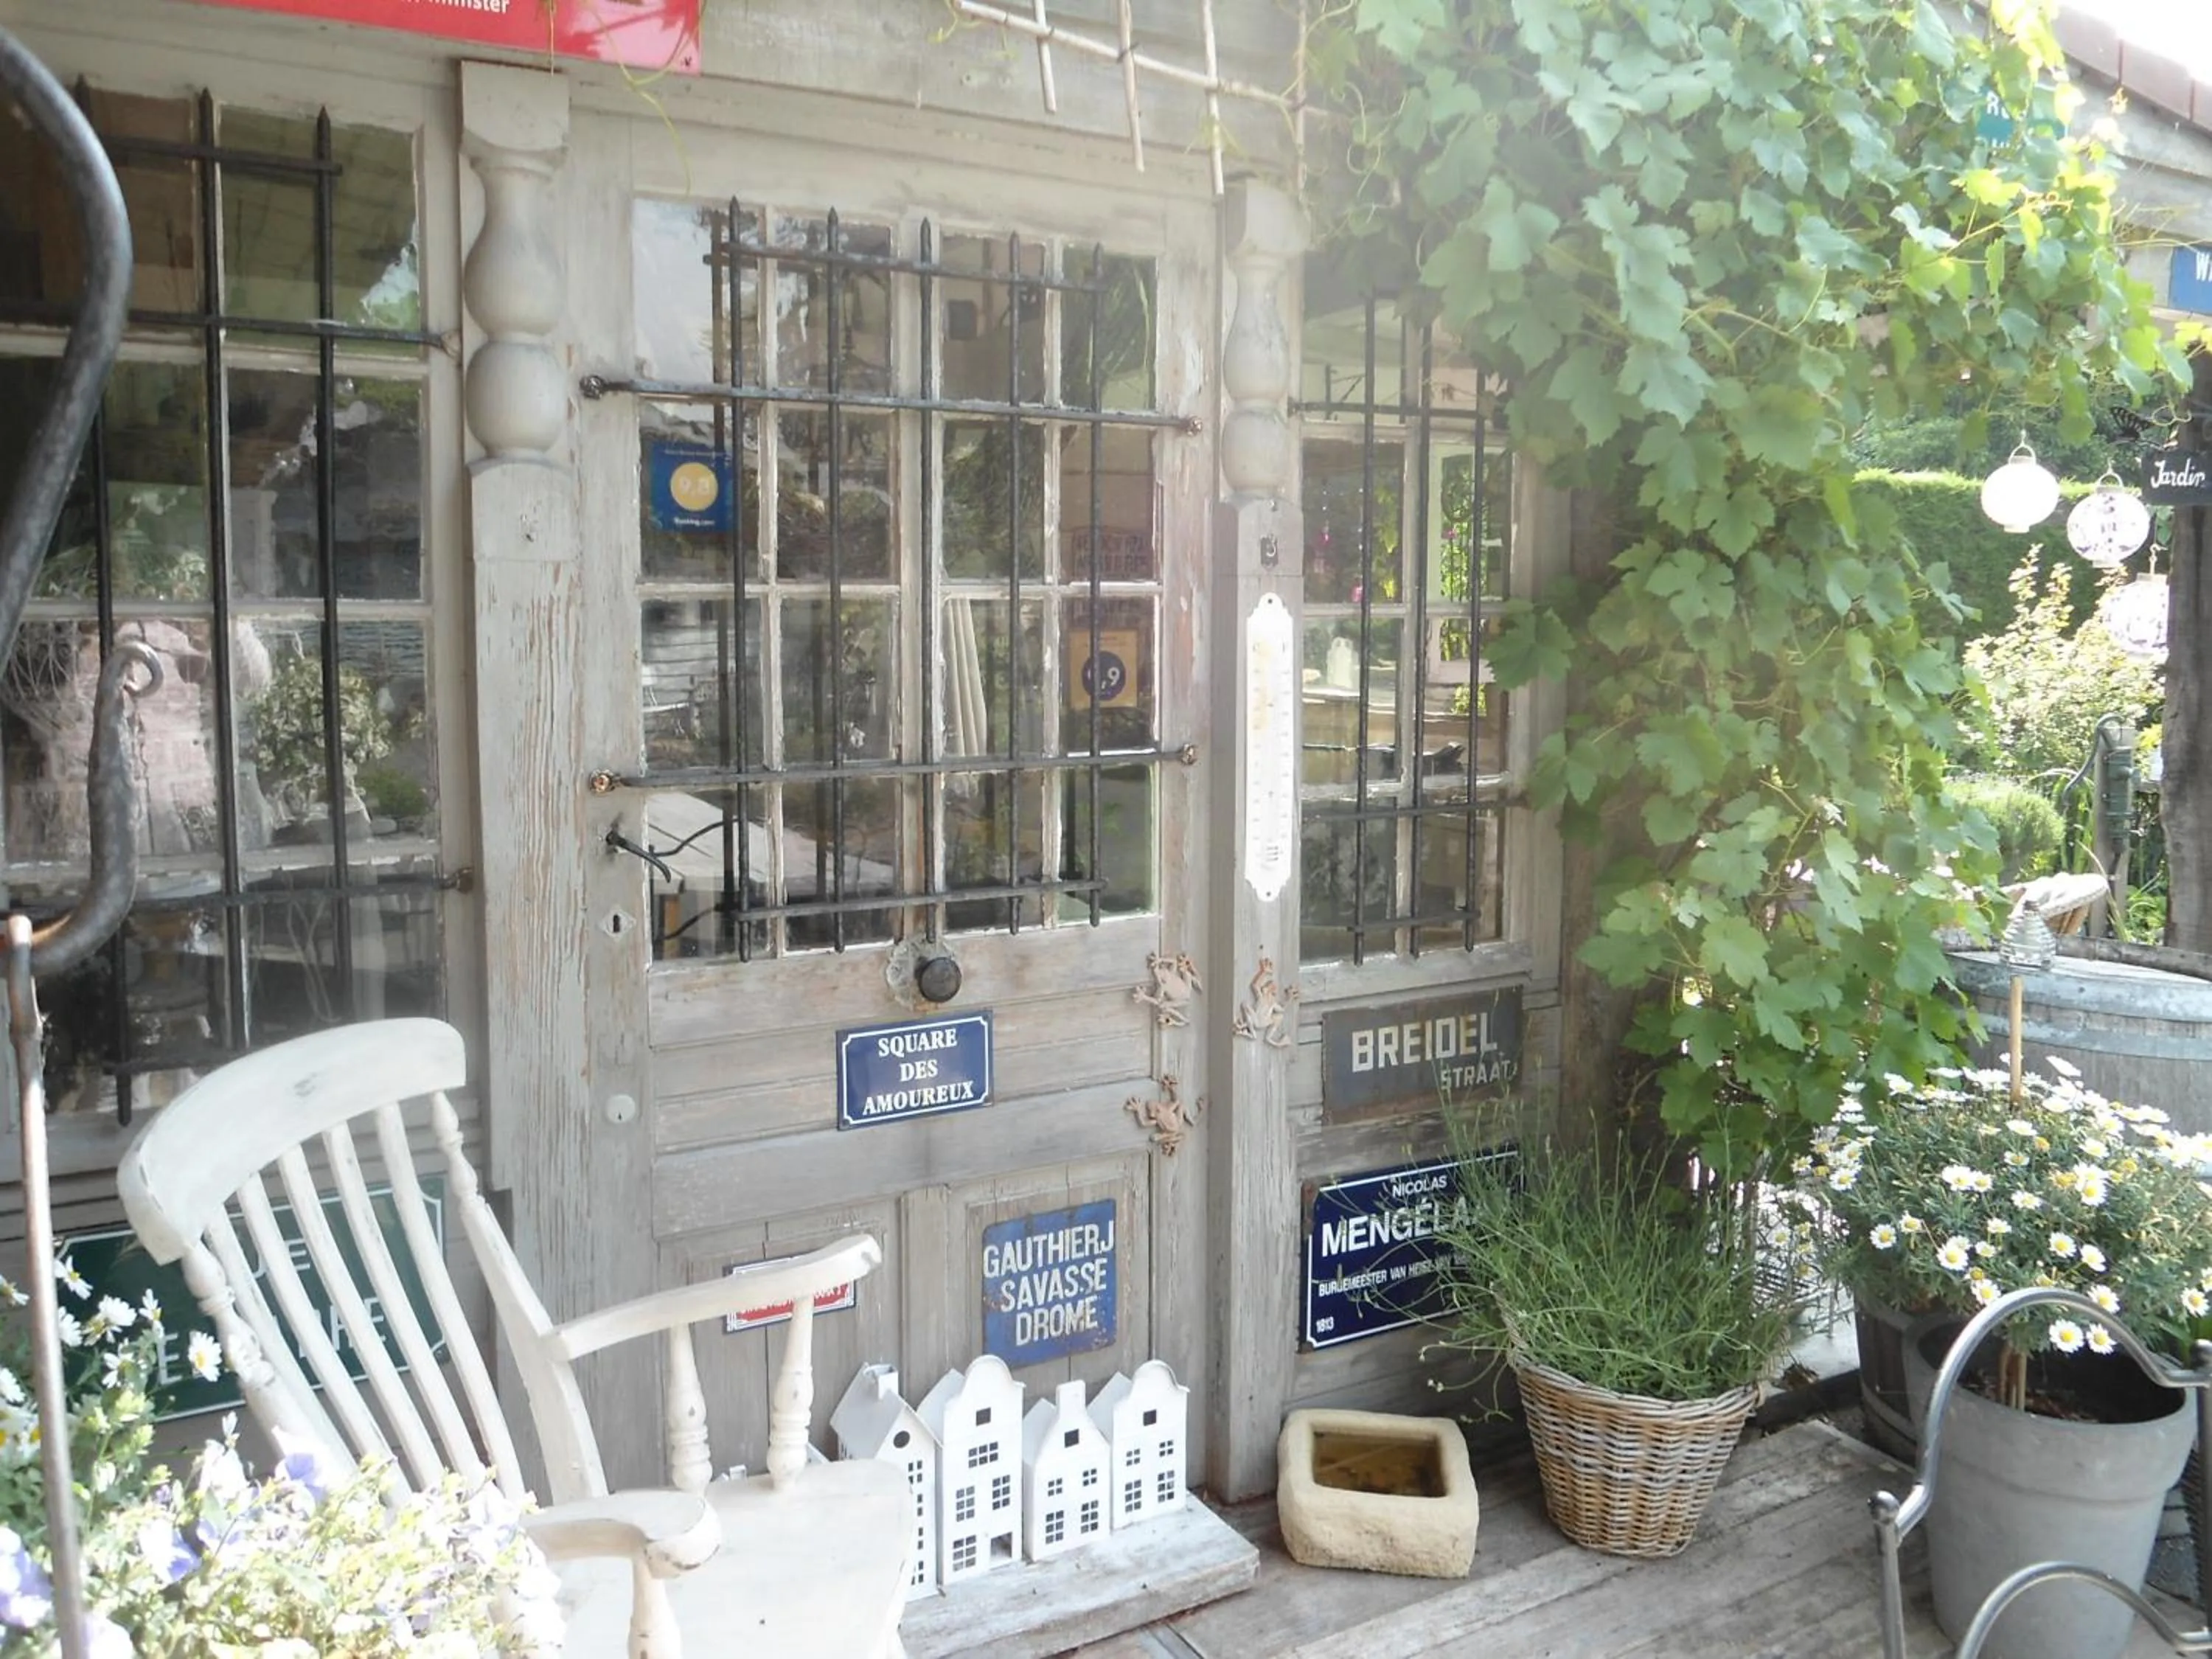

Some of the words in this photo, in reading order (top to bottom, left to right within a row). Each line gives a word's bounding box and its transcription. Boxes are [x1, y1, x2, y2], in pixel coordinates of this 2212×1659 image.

[878, 1029, 958, 1058] SQUARE
[1352, 1012, 1498, 1073] BREIDEL
[899, 1059, 939, 1082] DES
[1441, 1060, 1512, 1091] STRAAT
[862, 1080, 975, 1116] AMOUREUX
[1392, 1175, 1448, 1198] NICOLAS
[1390, 1264, 1407, 1281] VAN
[1015, 1295, 1099, 1347] DROME
